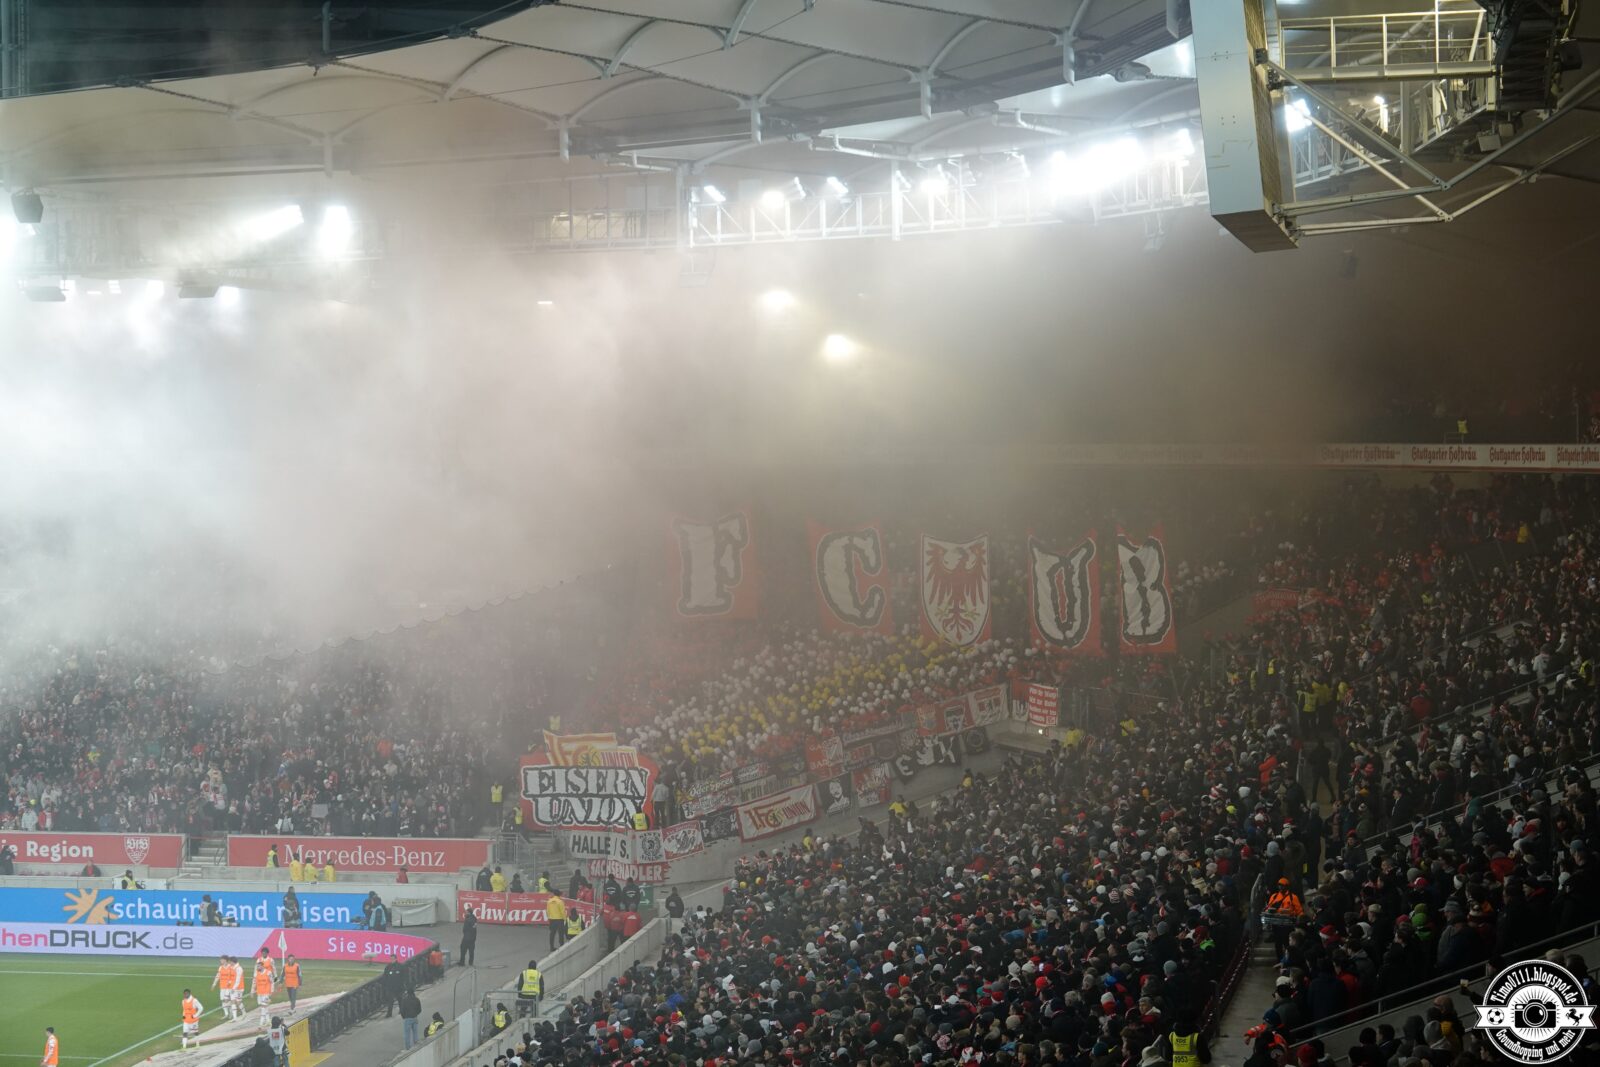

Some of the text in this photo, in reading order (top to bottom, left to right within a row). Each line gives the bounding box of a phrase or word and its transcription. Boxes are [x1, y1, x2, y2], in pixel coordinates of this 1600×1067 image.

[1411, 446, 1477, 464] Stuttgarter Hofbräu
[1489, 446, 1520, 465] Stuttgarter
[523, 766, 648, 797] EISERN
[531, 796, 644, 827] UNION
[26, 840, 94, 862] Region
[284, 844, 445, 867] Mercedes-Benz
[571, 834, 610, 855] HALLE
[619, 838, 629, 859] S.
[590, 859, 662, 881] SACHSENADLER
[113, 898, 350, 923] schauinland risen
[328, 937, 356, 953] Sie
[364, 941, 415, 958] sparen
